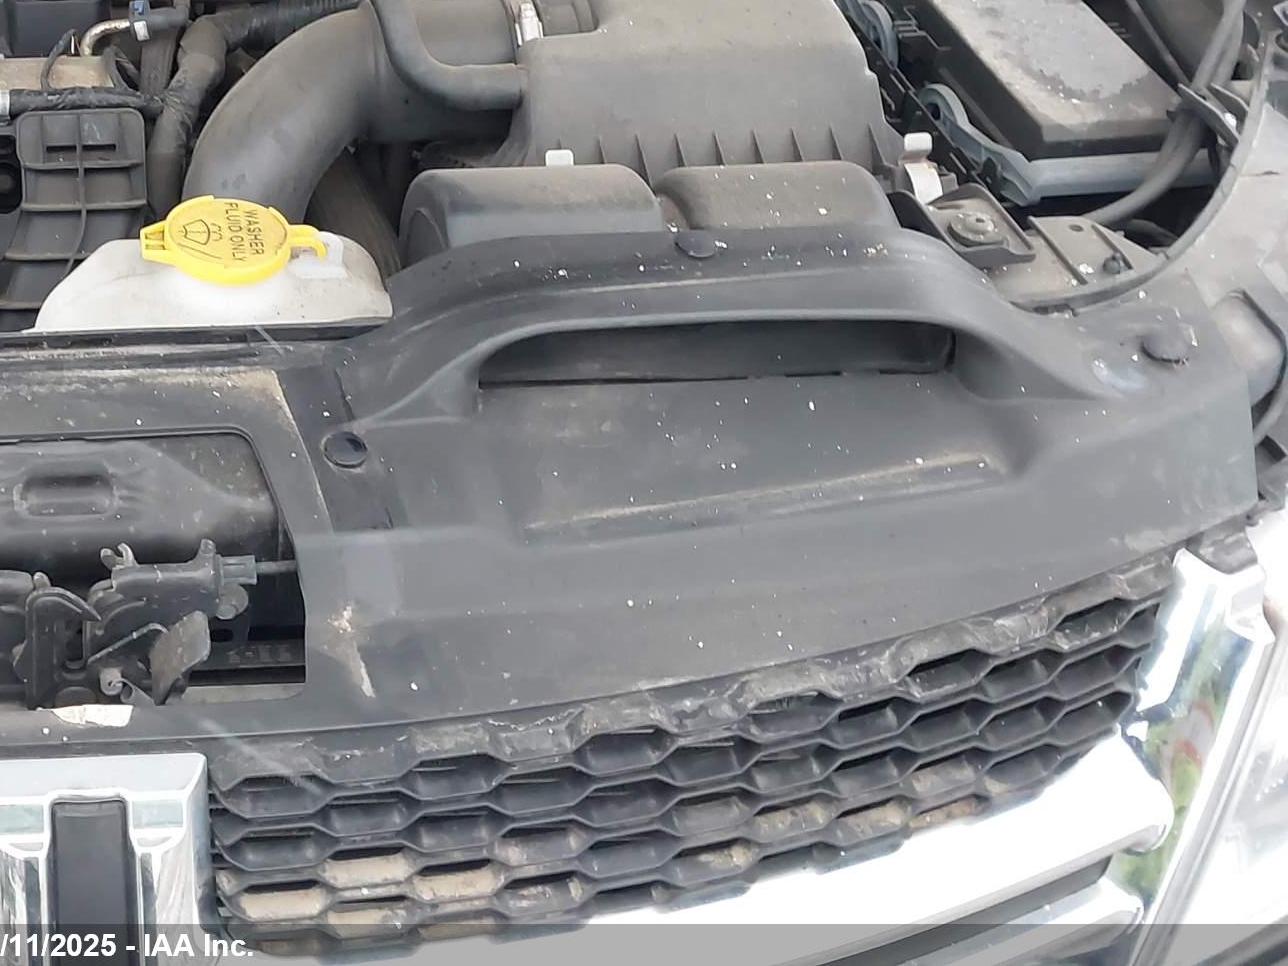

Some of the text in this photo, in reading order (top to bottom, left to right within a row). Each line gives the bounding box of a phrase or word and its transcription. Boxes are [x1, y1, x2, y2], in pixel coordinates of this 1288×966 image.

[224, 202, 248, 262] FLUID ONLY
[244, 209, 265, 256] WASHER
